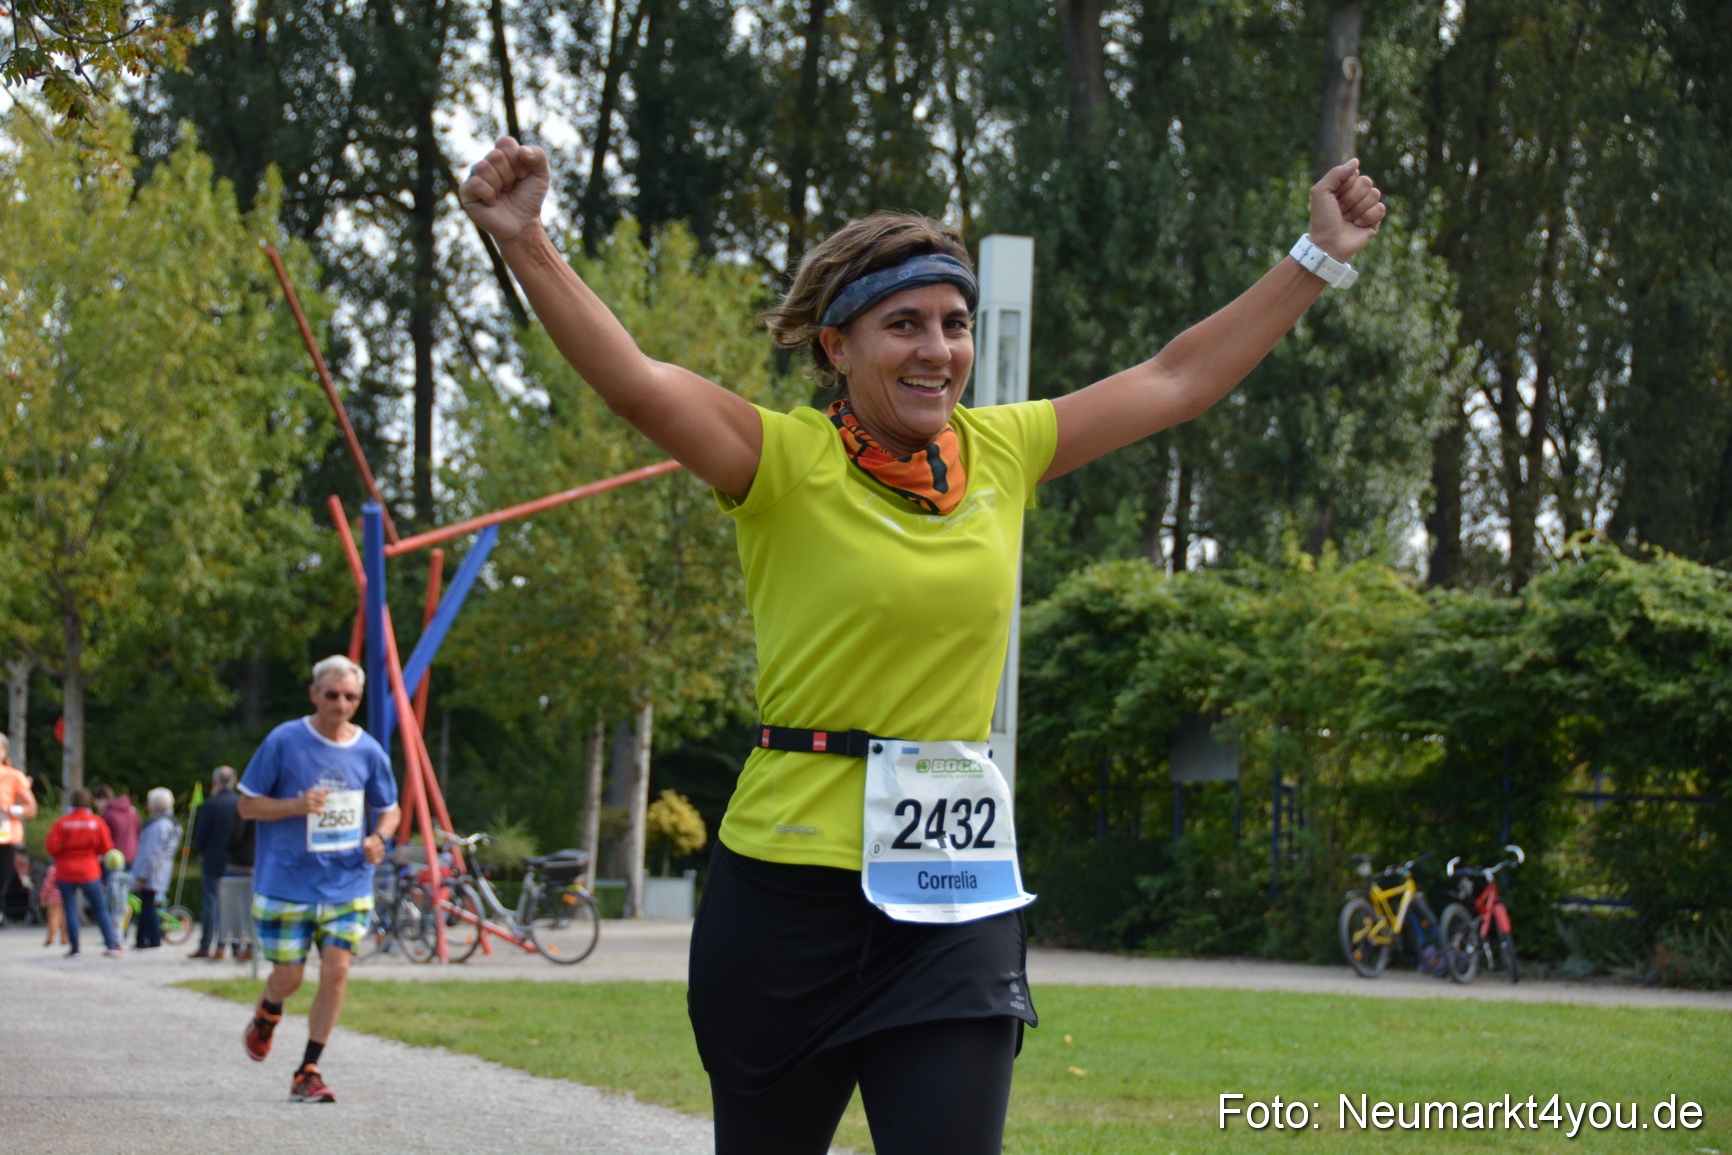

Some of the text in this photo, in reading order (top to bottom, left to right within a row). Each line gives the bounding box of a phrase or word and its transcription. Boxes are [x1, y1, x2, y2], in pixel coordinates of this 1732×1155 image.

[931, 758, 983, 773] BOCK
[318, 809, 355, 828] 2563
[891, 797, 996, 850] 2432
[775, 824, 817, 835] SPIRO
[874, 845, 880, 854] D
